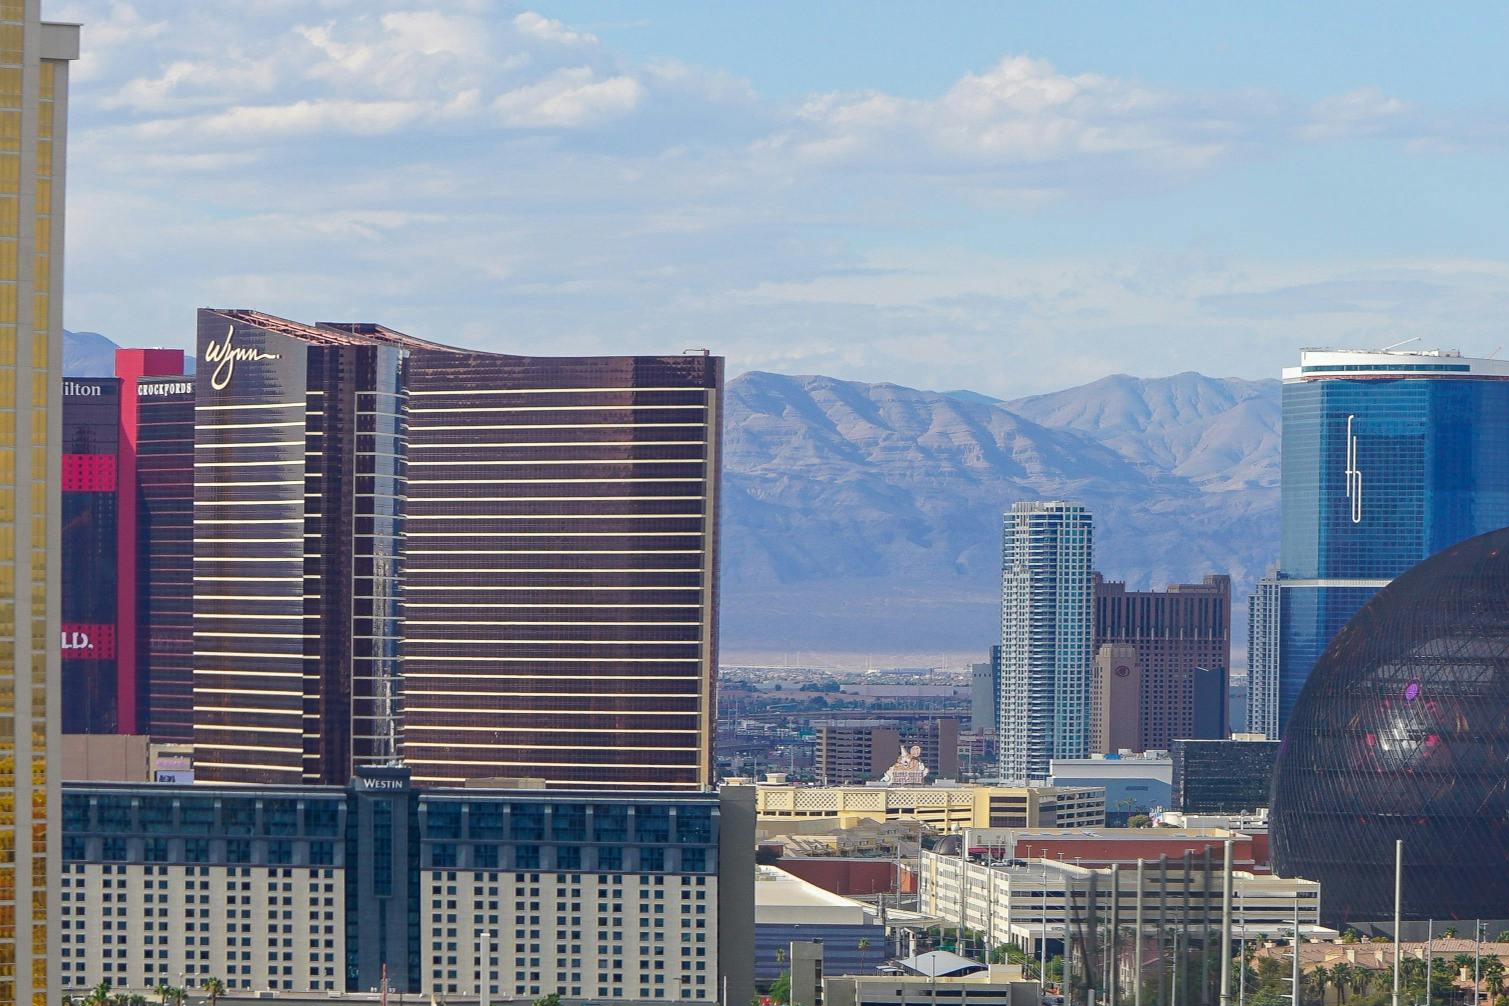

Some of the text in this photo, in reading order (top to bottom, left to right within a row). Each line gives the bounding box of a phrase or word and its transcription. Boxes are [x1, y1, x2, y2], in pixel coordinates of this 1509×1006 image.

[62, 382, 101, 396] ilton
[138, 382, 191, 397] CROCKFORDS
[363, 778, 403, 789] WESTIN
